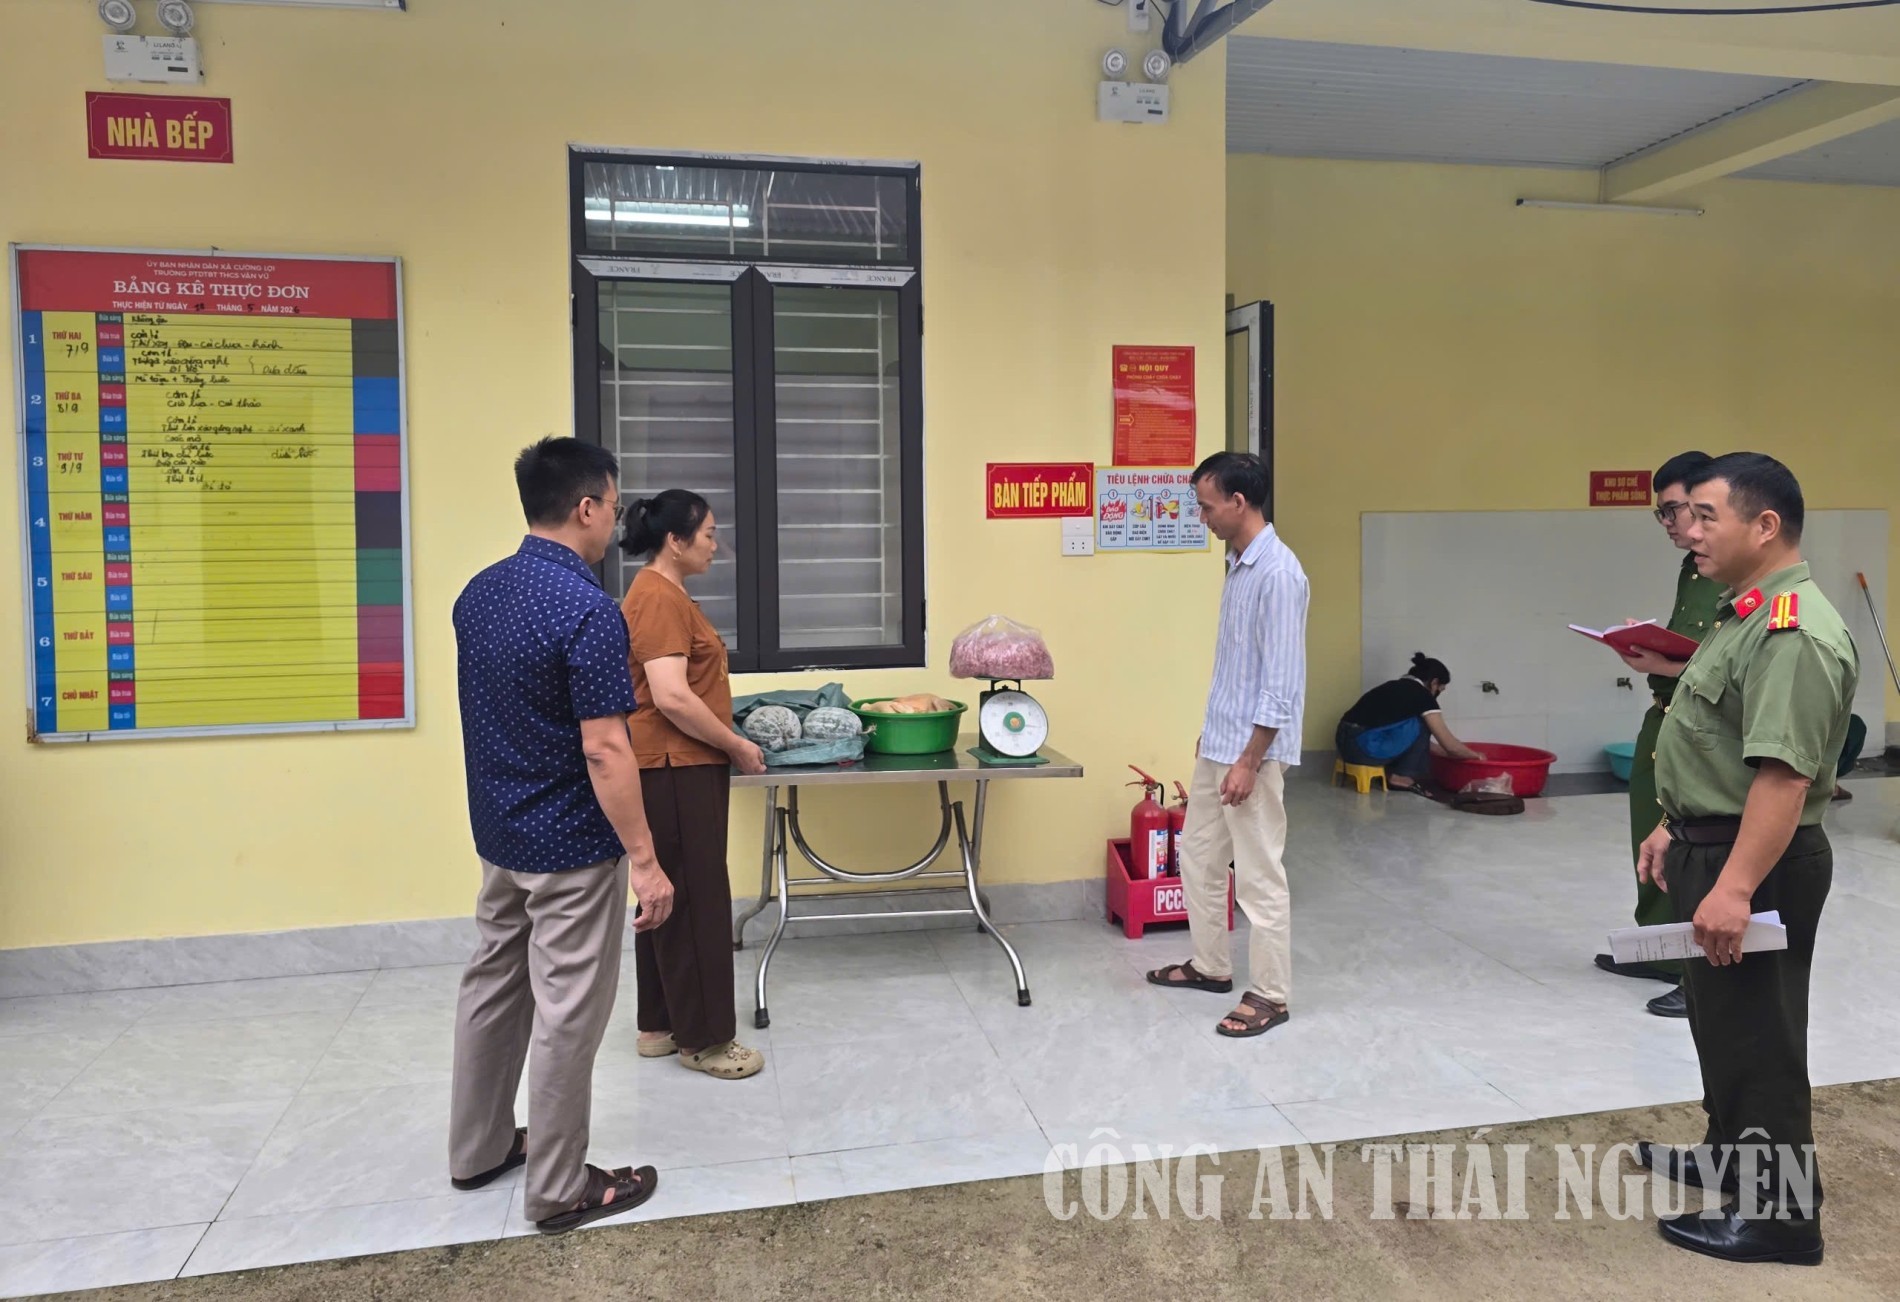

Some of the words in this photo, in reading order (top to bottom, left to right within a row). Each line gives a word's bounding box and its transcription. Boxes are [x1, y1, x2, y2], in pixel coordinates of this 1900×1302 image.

[108, 112, 159, 148] NHÀ
[166, 111, 213, 149] BẾP
[178, 260, 200, 269] NHÂN
[188, 270, 218, 278] PTDTBT
[608, 266, 640, 274] FRANCE
[114, 275, 170, 294] BẢNG
[176, 280, 205, 296] KÊ
[210, 283, 262, 300] THỰC
[268, 284, 310, 298] ĐƠN
[112, 300, 132, 310] THỰC
[135, 300, 152, 310] HIỆN
[166, 300, 188, 311] NGÀY
[216, 302, 243, 312] THÁNG
[261, 304, 278, 314] NĂM
[29, 334, 37, 344] 1
[53, 331, 67, 340] THỨ
[70, 332, 81, 340] HAI
[1139, 364, 1152, 372] NỘI
[31, 395, 42, 405] 2
[55, 391, 68, 400] THỨ
[72, 392, 81, 400] BA
[32, 456, 44, 466] 3
[57, 452, 72, 461] THỨ
[1107, 473, 1125, 484] TIÊU
[1128, 473, 1152, 486] LỆNH
[1154, 473, 1174, 484] CHỮA
[994, 477, 1019, 508] BÀN
[1022, 474, 1048, 507] TIẾP
[1052, 472, 1086, 507] PHẨM
[58, 512, 72, 520] THỨ
[34, 517, 46, 527] 4
[62, 572, 76, 580] THỨ
[78, 572, 92, 580] SÁU
[37, 577, 48, 587] 5
[64, 632, 78, 640] THỨ
[39, 637, 50, 647] 6
[62, 690, 77, 700] CHỦ
[41, 696, 52, 707] 7
[1157, 889, 1188, 911] PCC
